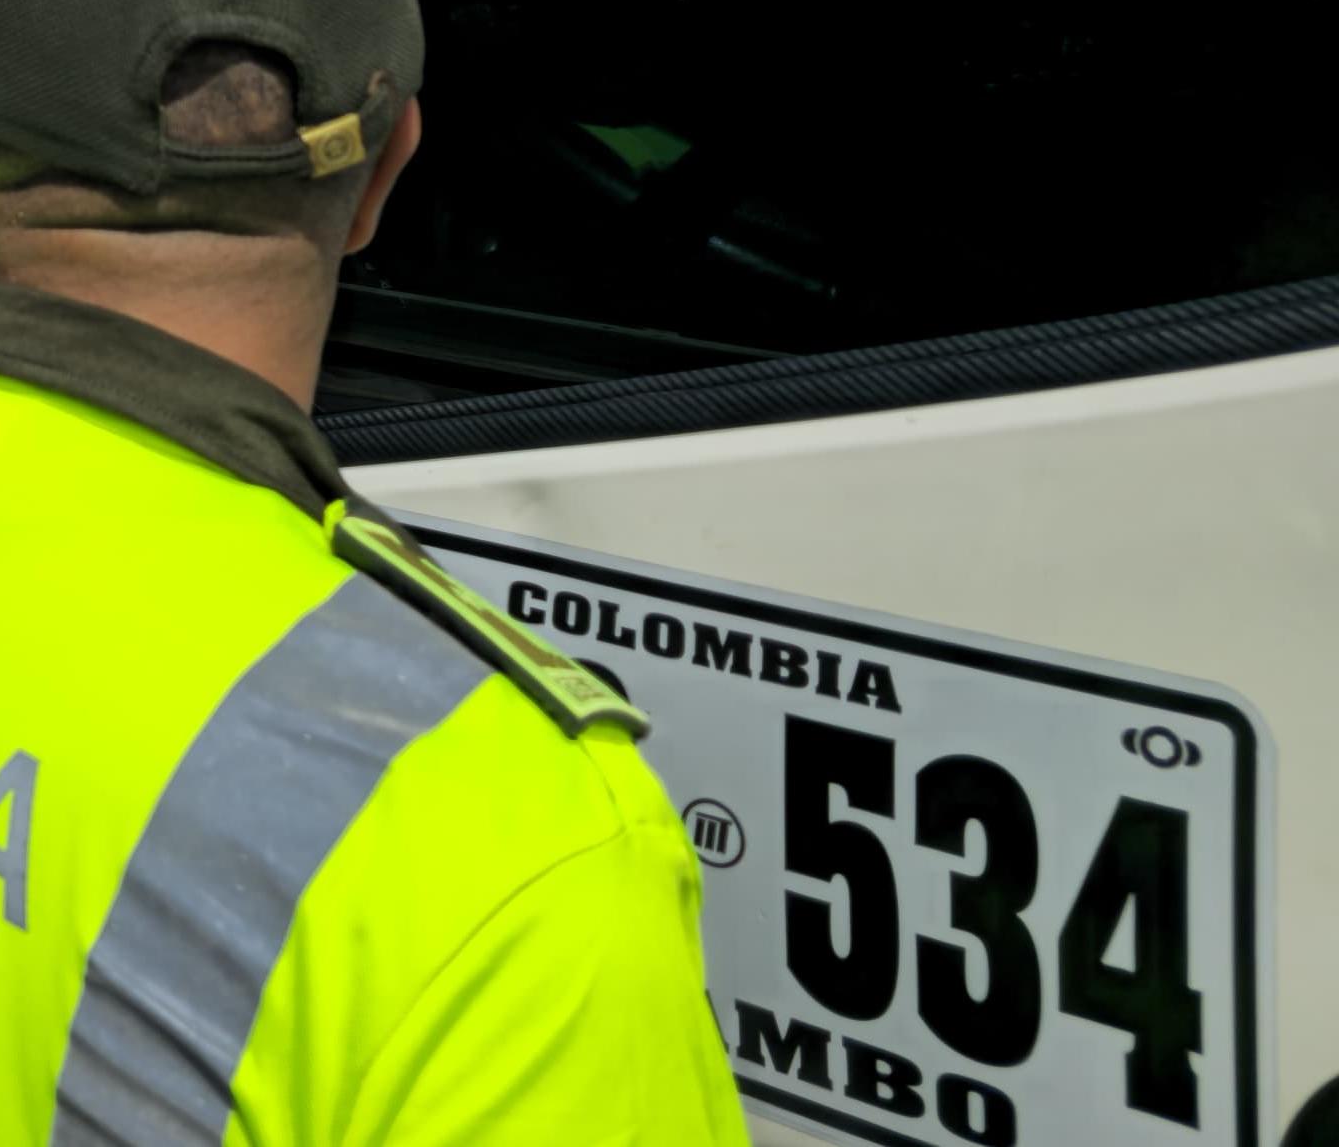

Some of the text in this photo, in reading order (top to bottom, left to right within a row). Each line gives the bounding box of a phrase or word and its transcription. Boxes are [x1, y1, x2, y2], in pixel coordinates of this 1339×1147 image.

[507, 579, 903, 714] COLOMBIA
[784, 712, 1204, 1130] 534
[706, 989, 1017, 1147] MBO
